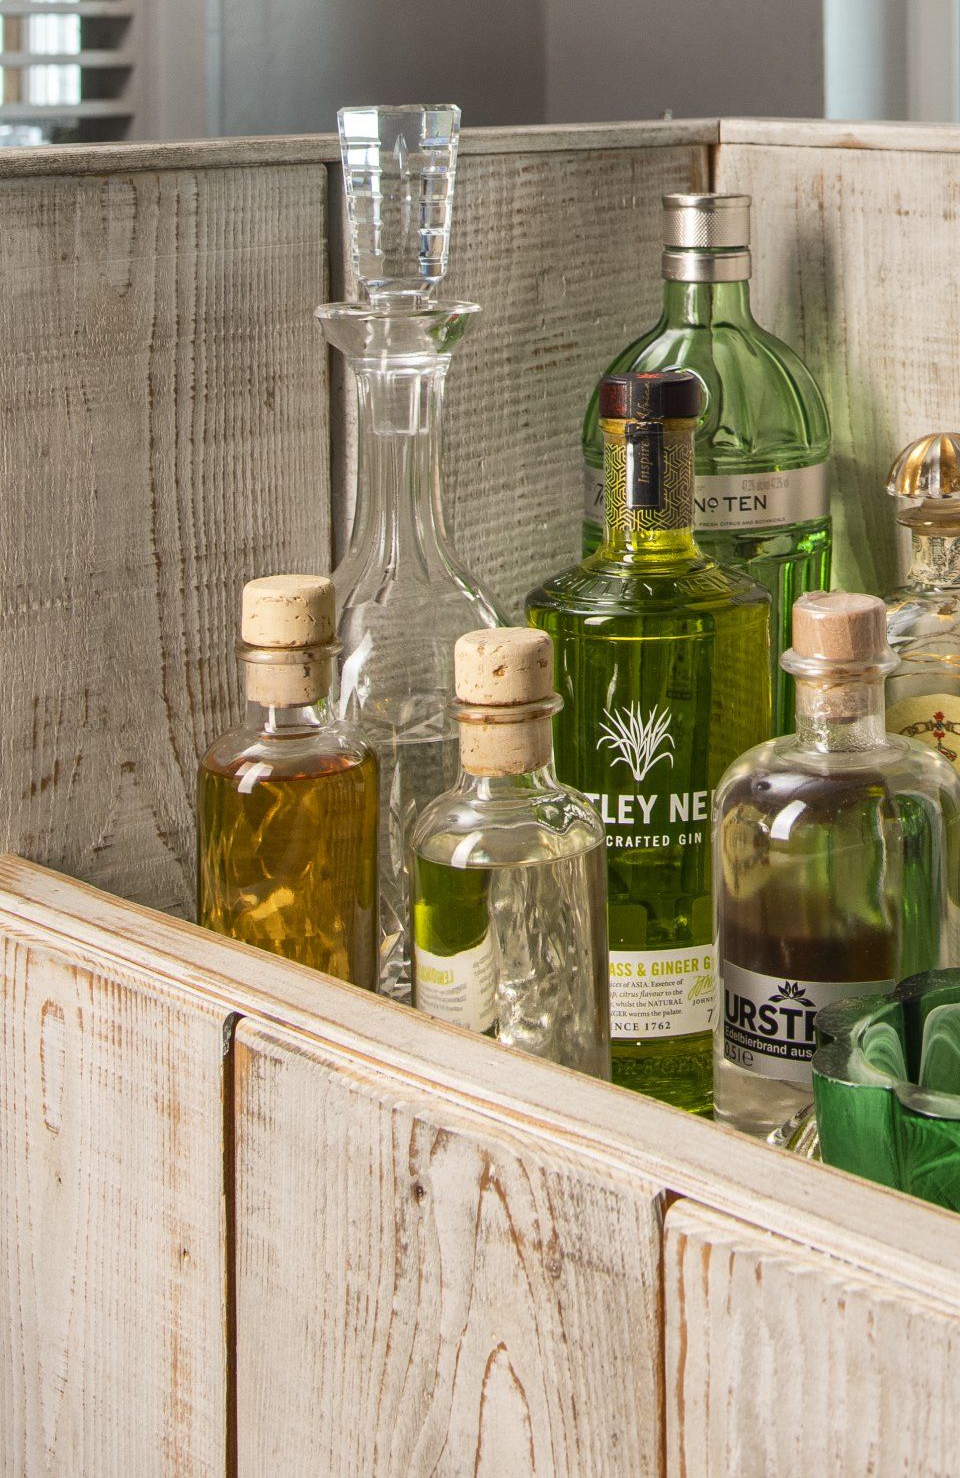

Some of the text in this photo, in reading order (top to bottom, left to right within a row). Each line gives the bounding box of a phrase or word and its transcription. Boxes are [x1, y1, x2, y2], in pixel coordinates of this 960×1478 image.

[722, 494, 768, 513] TEN
[669, 789, 716, 823] NE
[605, 832, 703, 848] CRAFTED GIN
[637, 962, 646, 977] &
[651, 957, 699, 976] GINGER
[639, 990, 664, 1000] flavour
[647, 998, 684, 1008] NATURAL
[645, 1021, 671, 1031] 1762
[725, 1025, 813, 1058] Edelbierbrand aus
